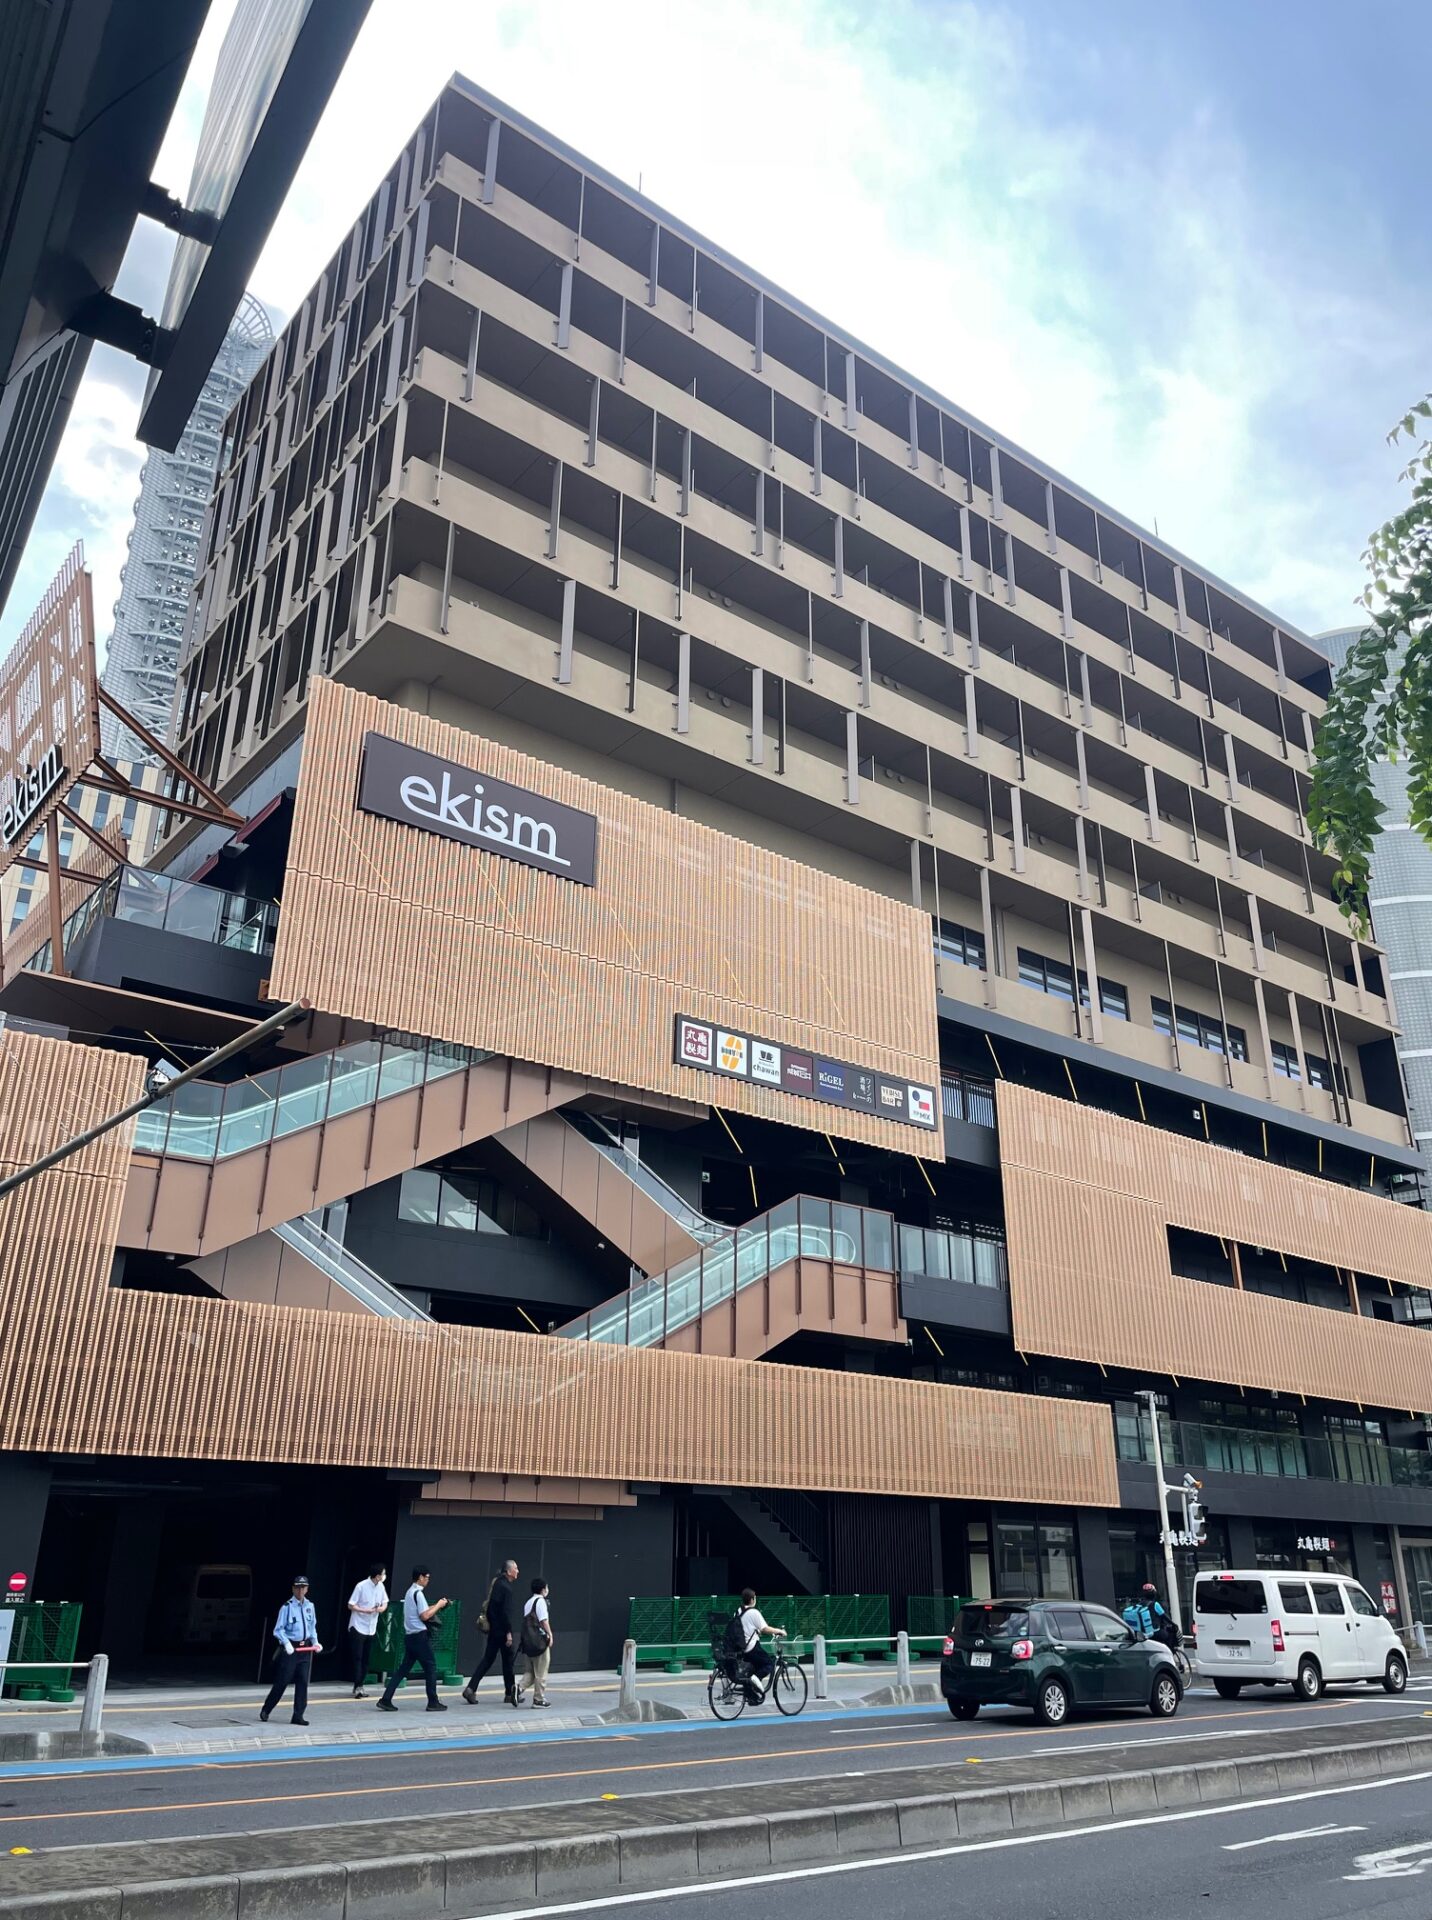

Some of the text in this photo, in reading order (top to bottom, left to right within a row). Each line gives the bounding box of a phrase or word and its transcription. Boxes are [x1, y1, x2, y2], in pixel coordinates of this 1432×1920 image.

[2, 745, 64, 844] ekism
[400, 771, 571, 867] ekism
[752, 1063, 780, 1077] chawan
[882, 1096, 894, 1105] BAR
[1297, 1536, 1331, 1552] 丸亀製麺
